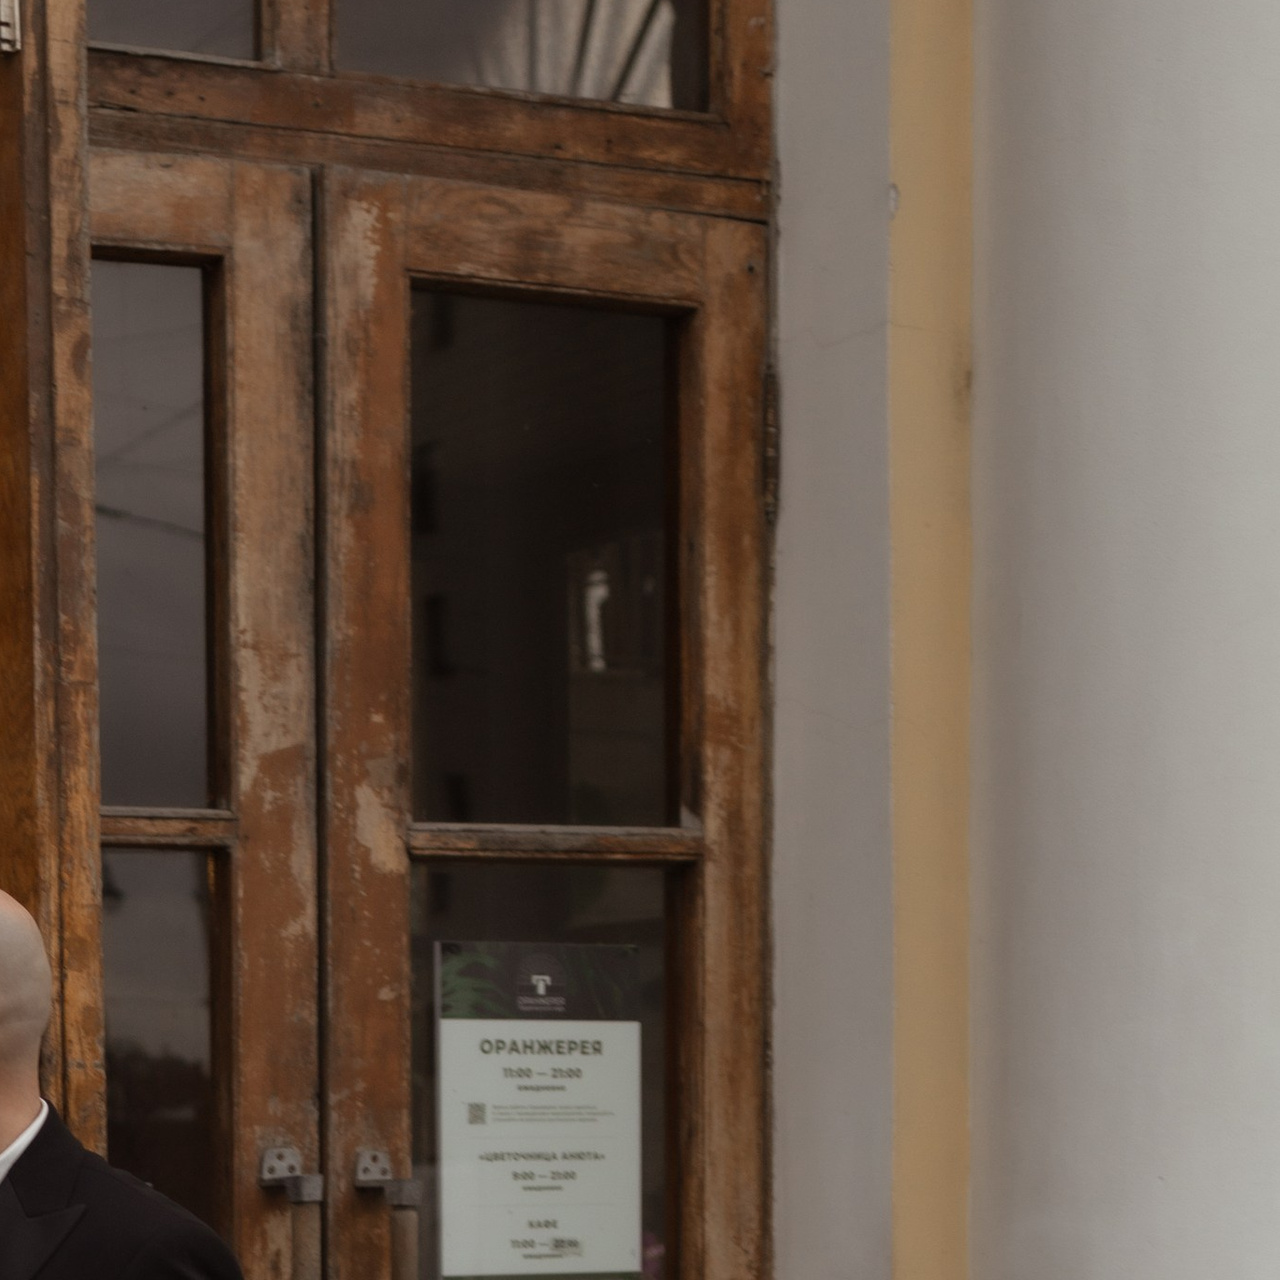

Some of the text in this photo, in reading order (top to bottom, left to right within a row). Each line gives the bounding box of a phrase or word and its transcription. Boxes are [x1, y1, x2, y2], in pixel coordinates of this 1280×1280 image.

[480, 1039, 603, 1055] ОРАНЖЕРЕЯ
[503, 1067, 533, 1078] 11:00
[551, 1067, 582, 1078] 21:00
